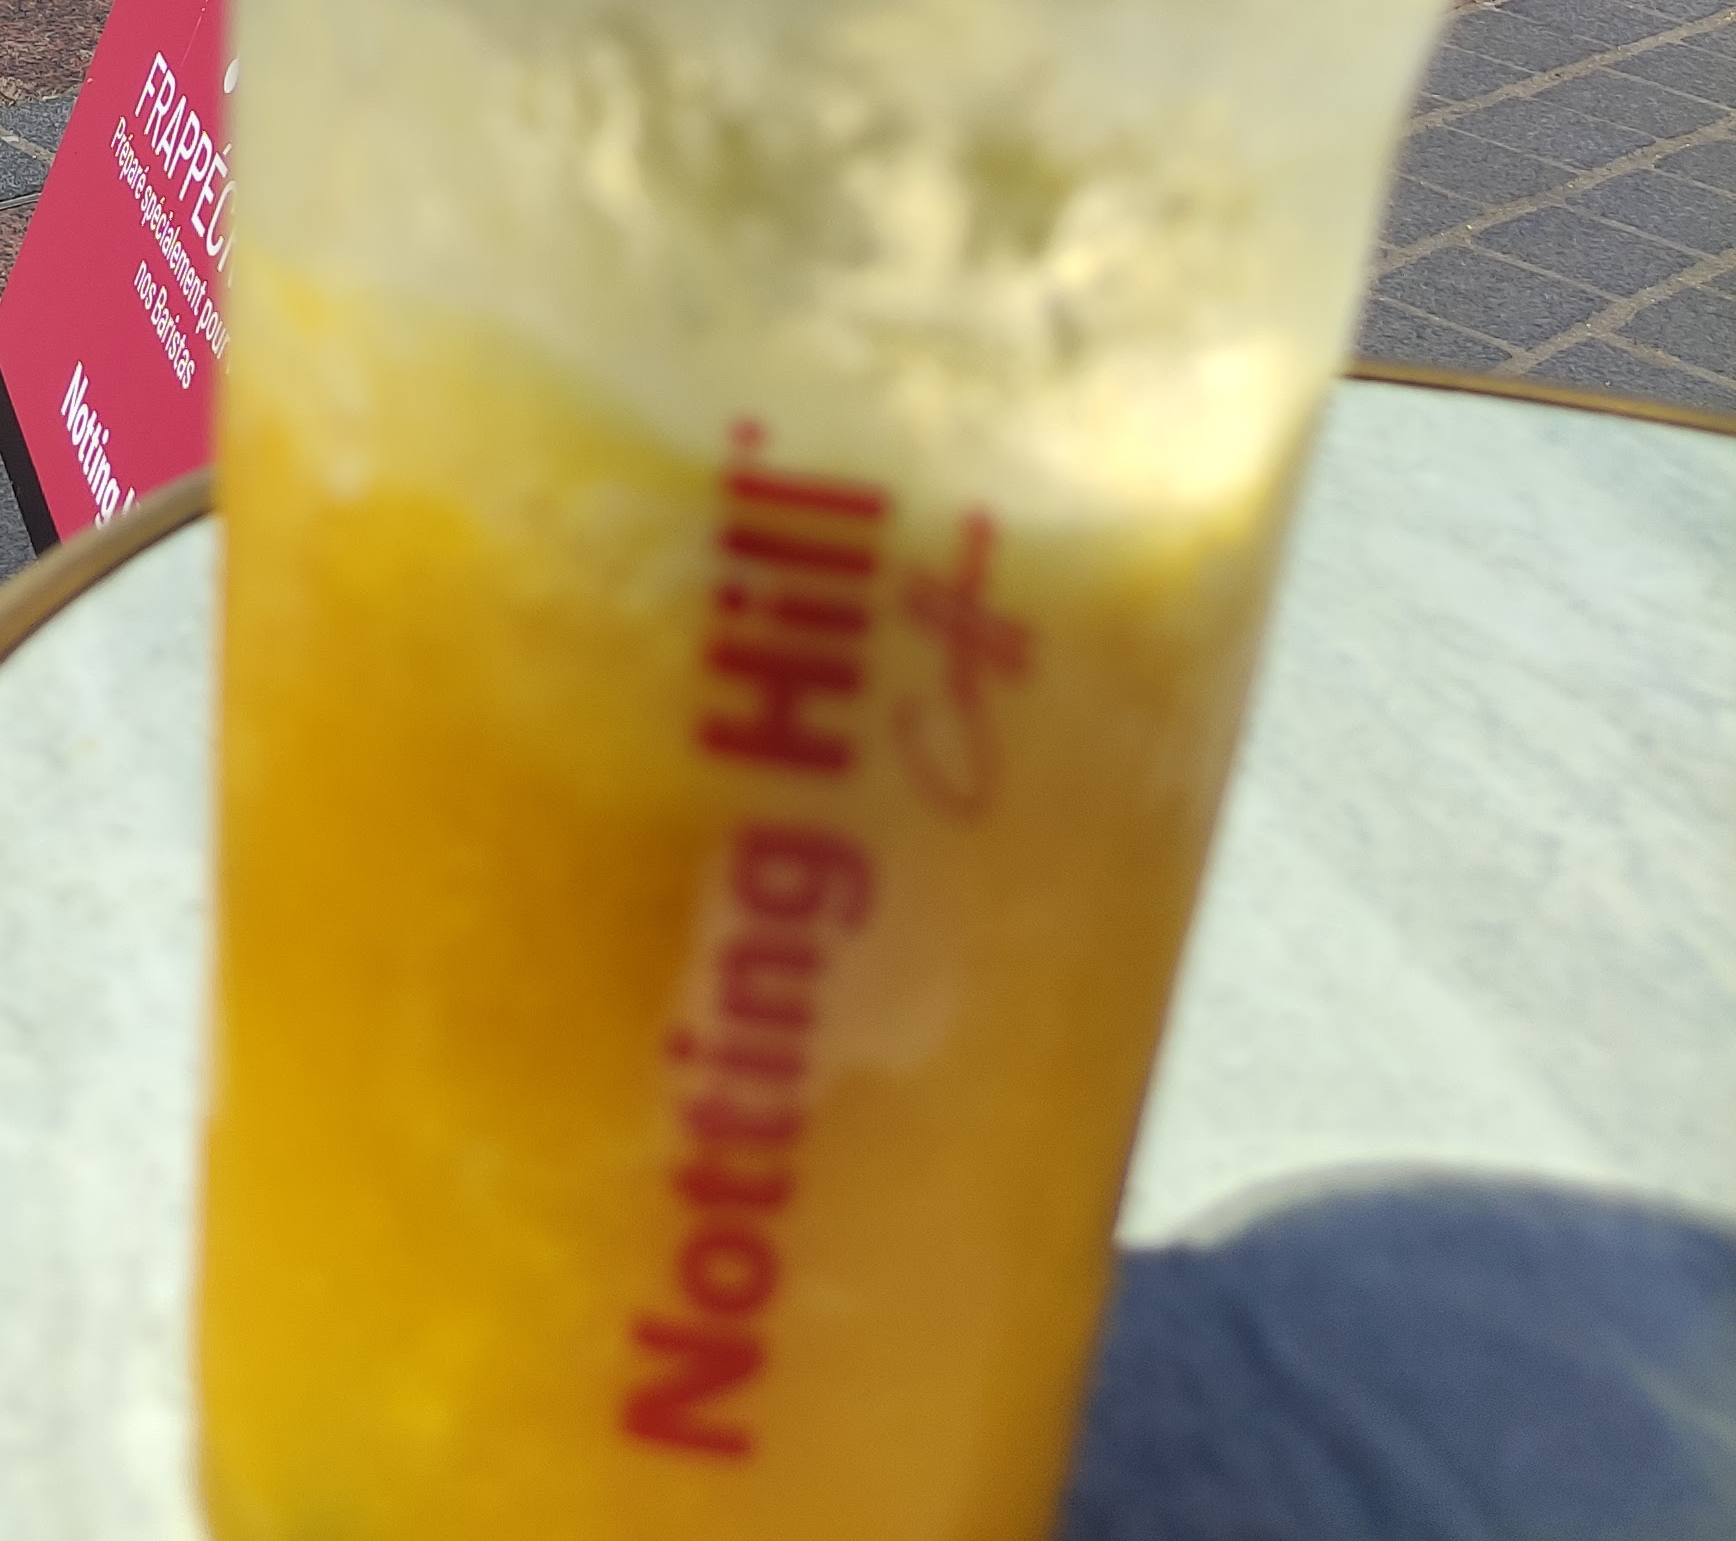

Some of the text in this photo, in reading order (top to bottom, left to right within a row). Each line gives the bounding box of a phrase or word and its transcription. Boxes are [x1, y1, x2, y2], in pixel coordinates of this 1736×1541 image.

[110, 115, 232, 363] Préparé spécialement pour
[132, 258, 196, 390] nos Baristas
[59, 359, 122, 531] Notting
[619, 457, 892, 1462] Notting Hill
